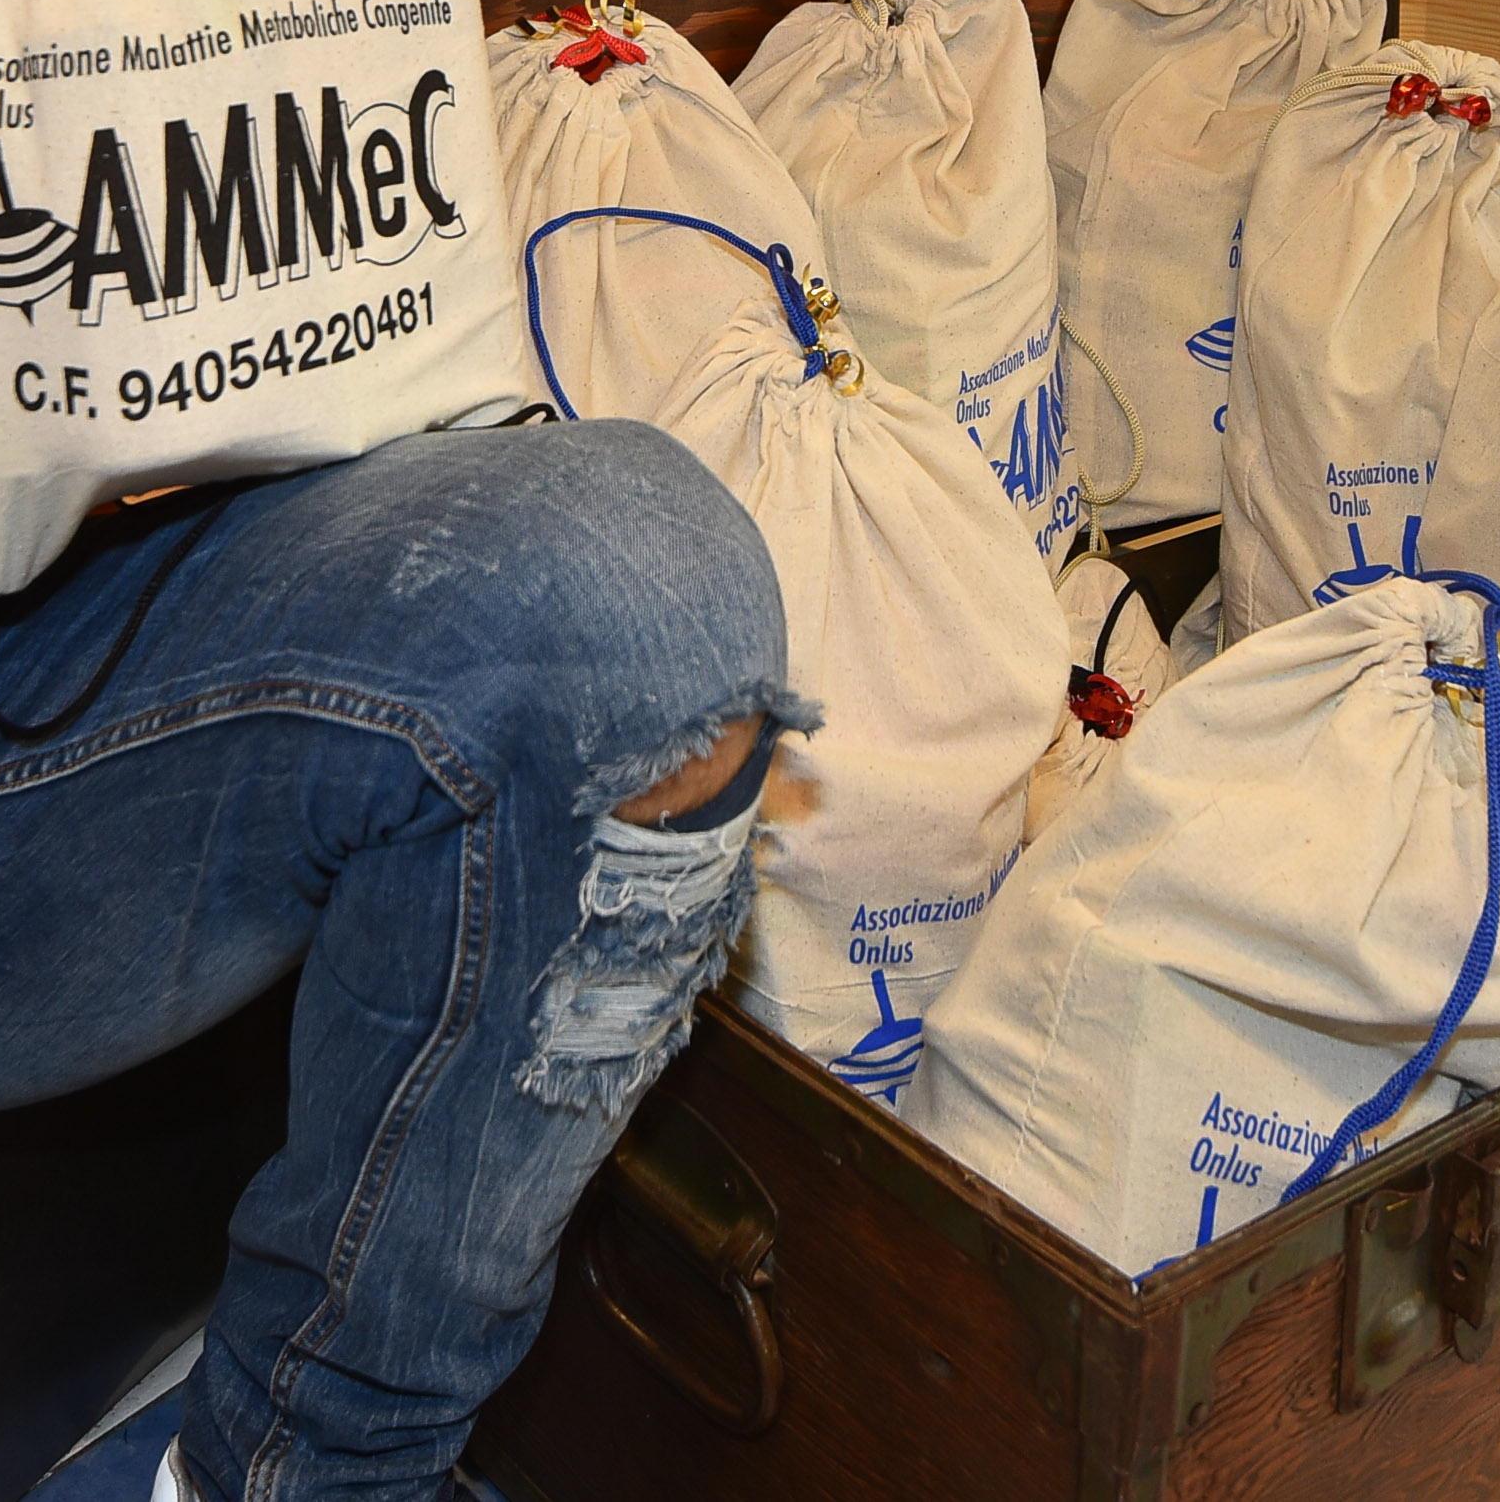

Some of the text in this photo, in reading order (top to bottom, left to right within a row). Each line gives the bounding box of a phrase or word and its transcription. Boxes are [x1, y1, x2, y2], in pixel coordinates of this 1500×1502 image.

[122, 24, 233, 74] Malattie
[70, 69, 466, 326] AMMeC
[14, 282, 436, 421] C.F. 94054220481
[959, 348, 1025, 395] Associazione
[956, 393, 991, 424] Onlus
[1326, 461, 1419, 487] Associazione
[1329, 492, 1371, 517] Onlus
[851, 891, 985, 932] Associazione
[849, 935, 914, 965] Onlus
[1190, 1136, 1262, 1187] Onlus
